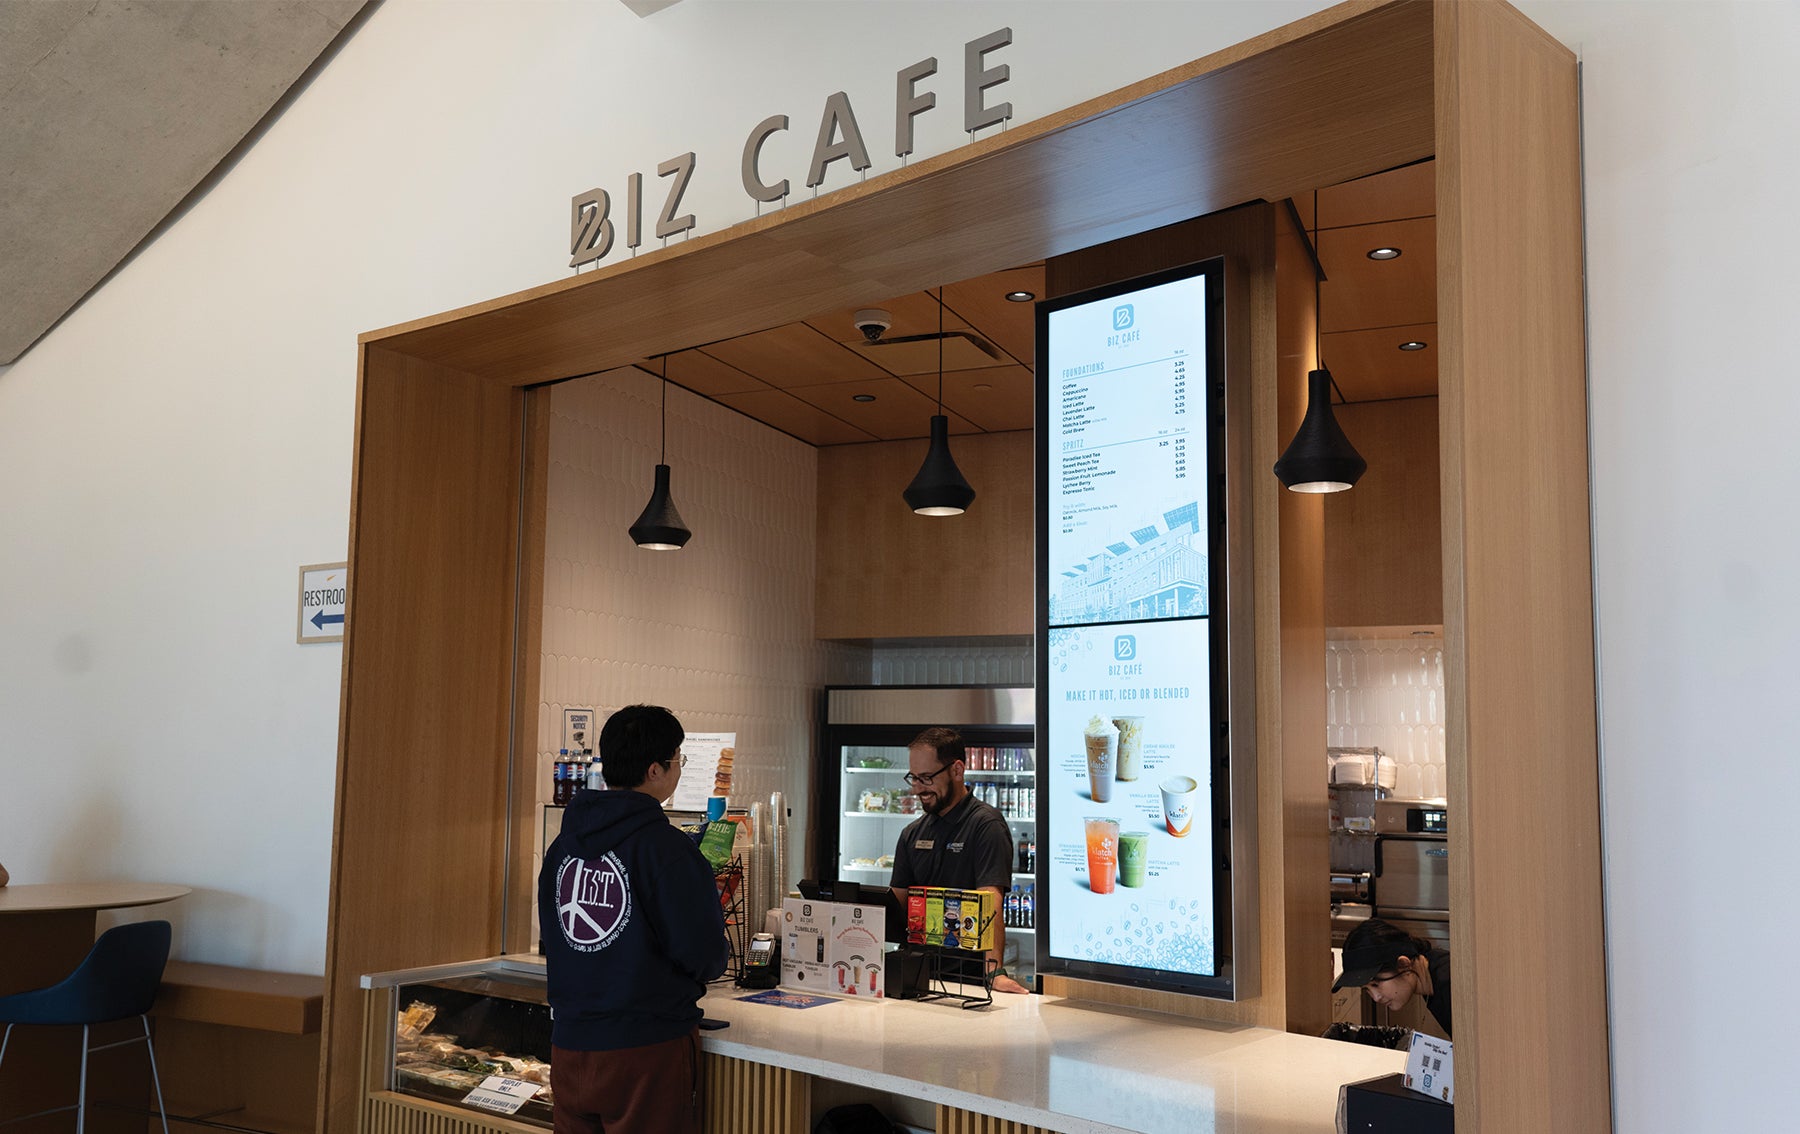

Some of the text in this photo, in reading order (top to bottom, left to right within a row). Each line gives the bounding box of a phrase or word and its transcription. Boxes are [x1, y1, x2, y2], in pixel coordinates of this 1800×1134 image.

[569, 27, 1012, 268] BIZ CAFE
[1107, 329, 1140, 347] BIZ CAFE
[1063, 361, 1104, 378] FOUNDATIONS
[1063, 388, 1088, 396] Cappuccino
[1062, 439, 1084, 450] SPRITZ
[304, 588, 345, 607] RESTROO
[1108, 664, 1142, 676] BIZ CAFE
[1066, 690, 1086, 702] MAKE
[1089, 690, 1096, 701] IT
[1120, 689, 1137, 700] ICED
[1140, 688, 1150, 700] OR
[1154, 687, 1190, 700] BLENDED
[795, 925, 818, 934] TUMBLERS
[501, 1079, 522, 1088] DISPLAY
[490, 1099, 510, 1108] CASHIER
